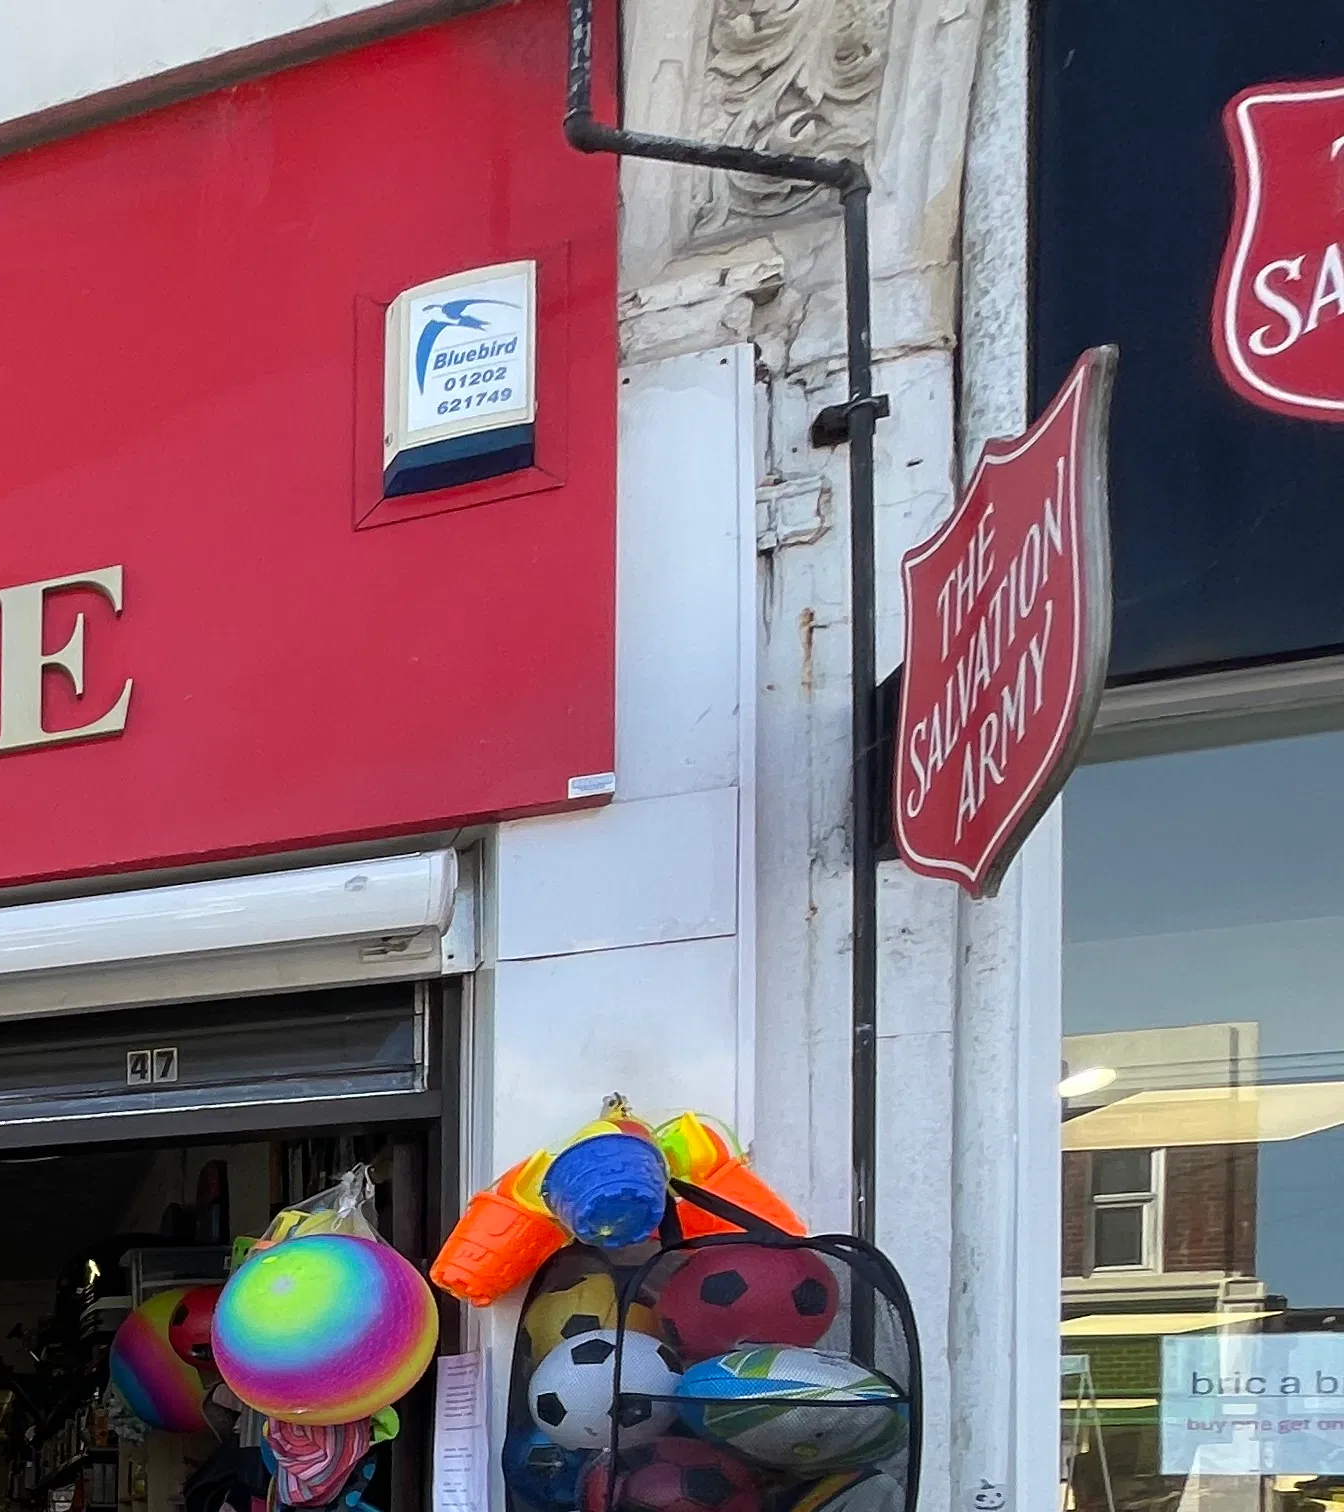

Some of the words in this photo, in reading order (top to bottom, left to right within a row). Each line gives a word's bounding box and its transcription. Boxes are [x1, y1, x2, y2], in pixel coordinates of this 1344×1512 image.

[432, 337, 518, 371] Bluebird
[444, 366, 508, 392] 01202
[437, 387, 513, 415] 621749
[937, 502, 996, 662] THE
[907, 456, 1067, 818] SALVATION
[955, 600, 1053, 845] ARMY
[129, 1050, 177, 1082] 47
[1191, 1370, 1267, 1396] bric
[1279, 1375, 1301, 1394] a
[1186, 1418, 1226, 1433] buy
[1277, 1418, 1311, 1435] get
